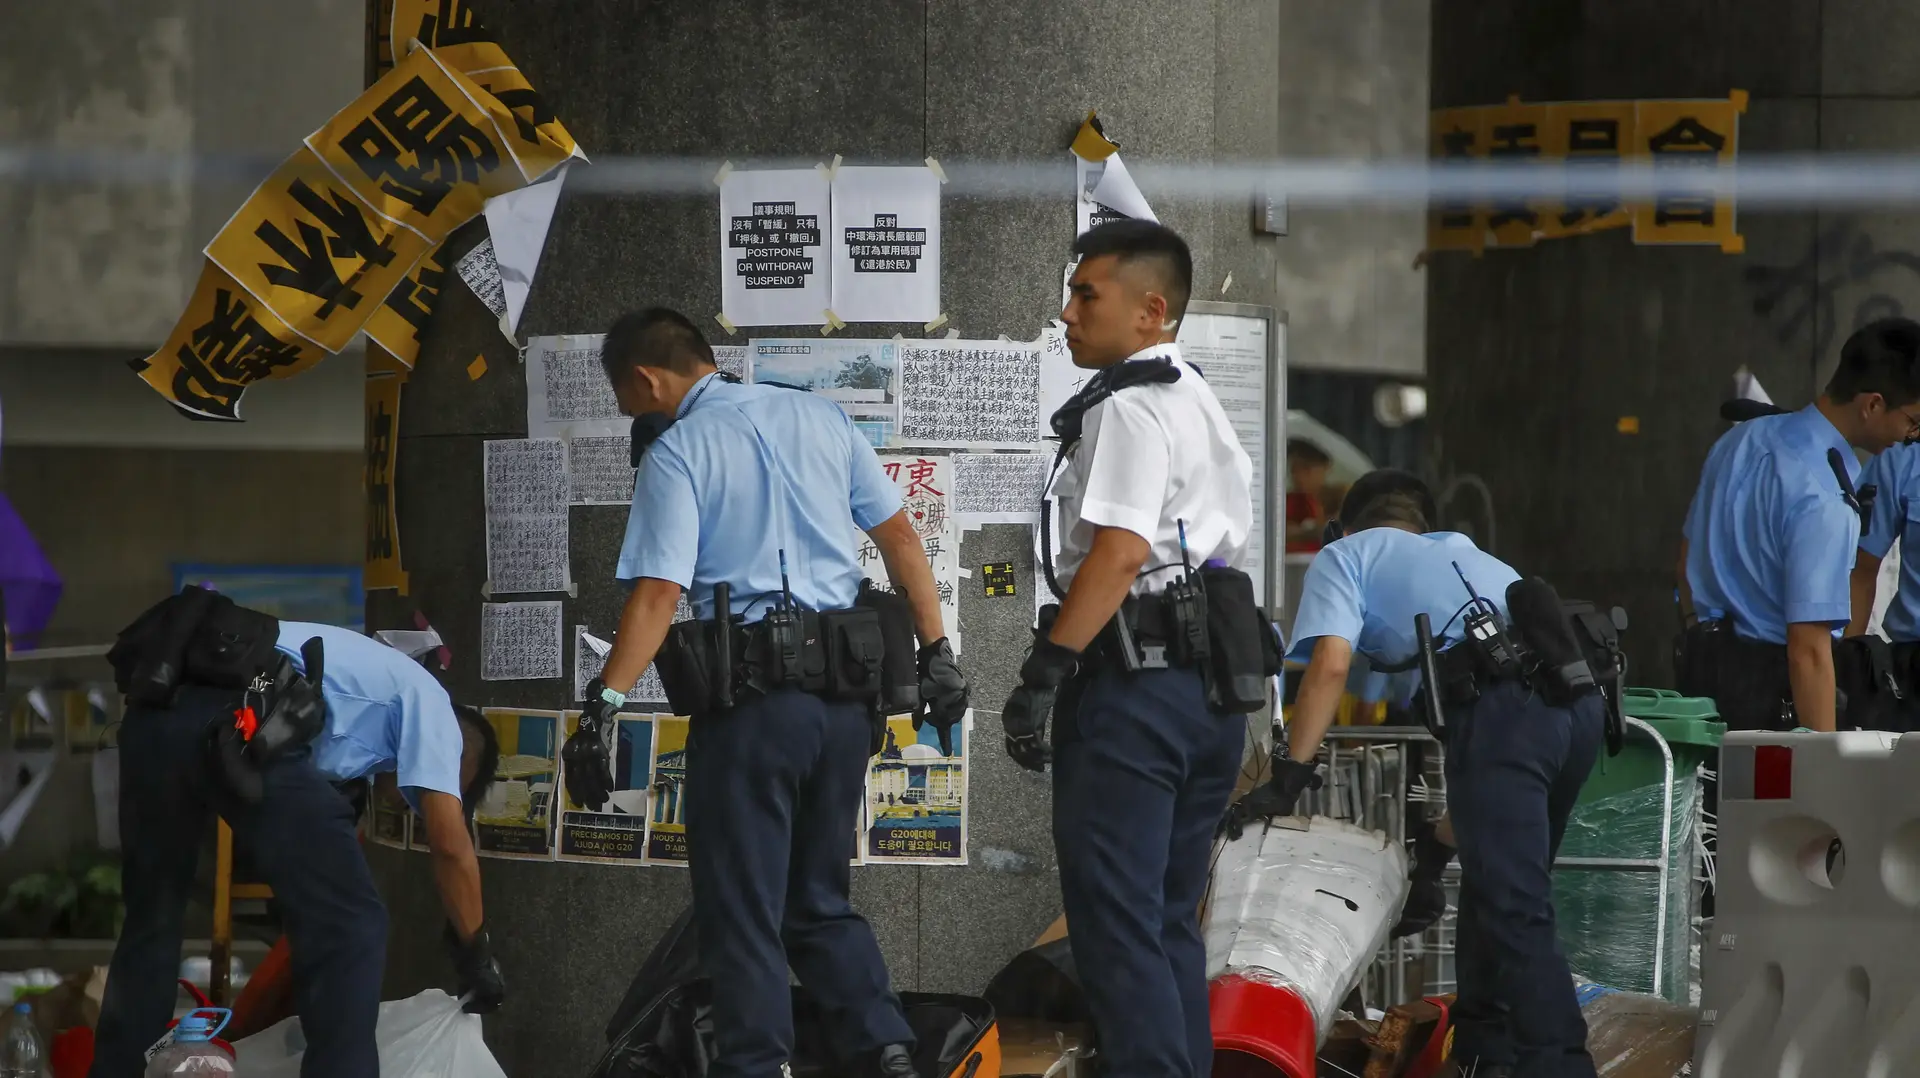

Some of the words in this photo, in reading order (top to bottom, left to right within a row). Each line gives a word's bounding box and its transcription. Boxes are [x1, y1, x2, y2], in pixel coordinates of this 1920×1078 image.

[754, 205, 795, 216] 議事規則
[875, 217, 896, 227] 反對
[747, 248, 802, 257] POSTPONE
[738, 262, 753, 272] OR
[756, 261, 812, 272] WITHDRAW
[746, 276, 795, 286] SUSPEND
[570, 829, 621, 841] PRECISAMOS
[623, 833, 635, 842] DE
[653, 834, 675, 842] NOUS
[890, 829, 937, 840] G20에대해
[574, 841, 600, 850] AJUDA
[602, 842, 614, 851] NO
[616, 843, 633, 852] G20
[877, 840, 904, 851] 도움이
